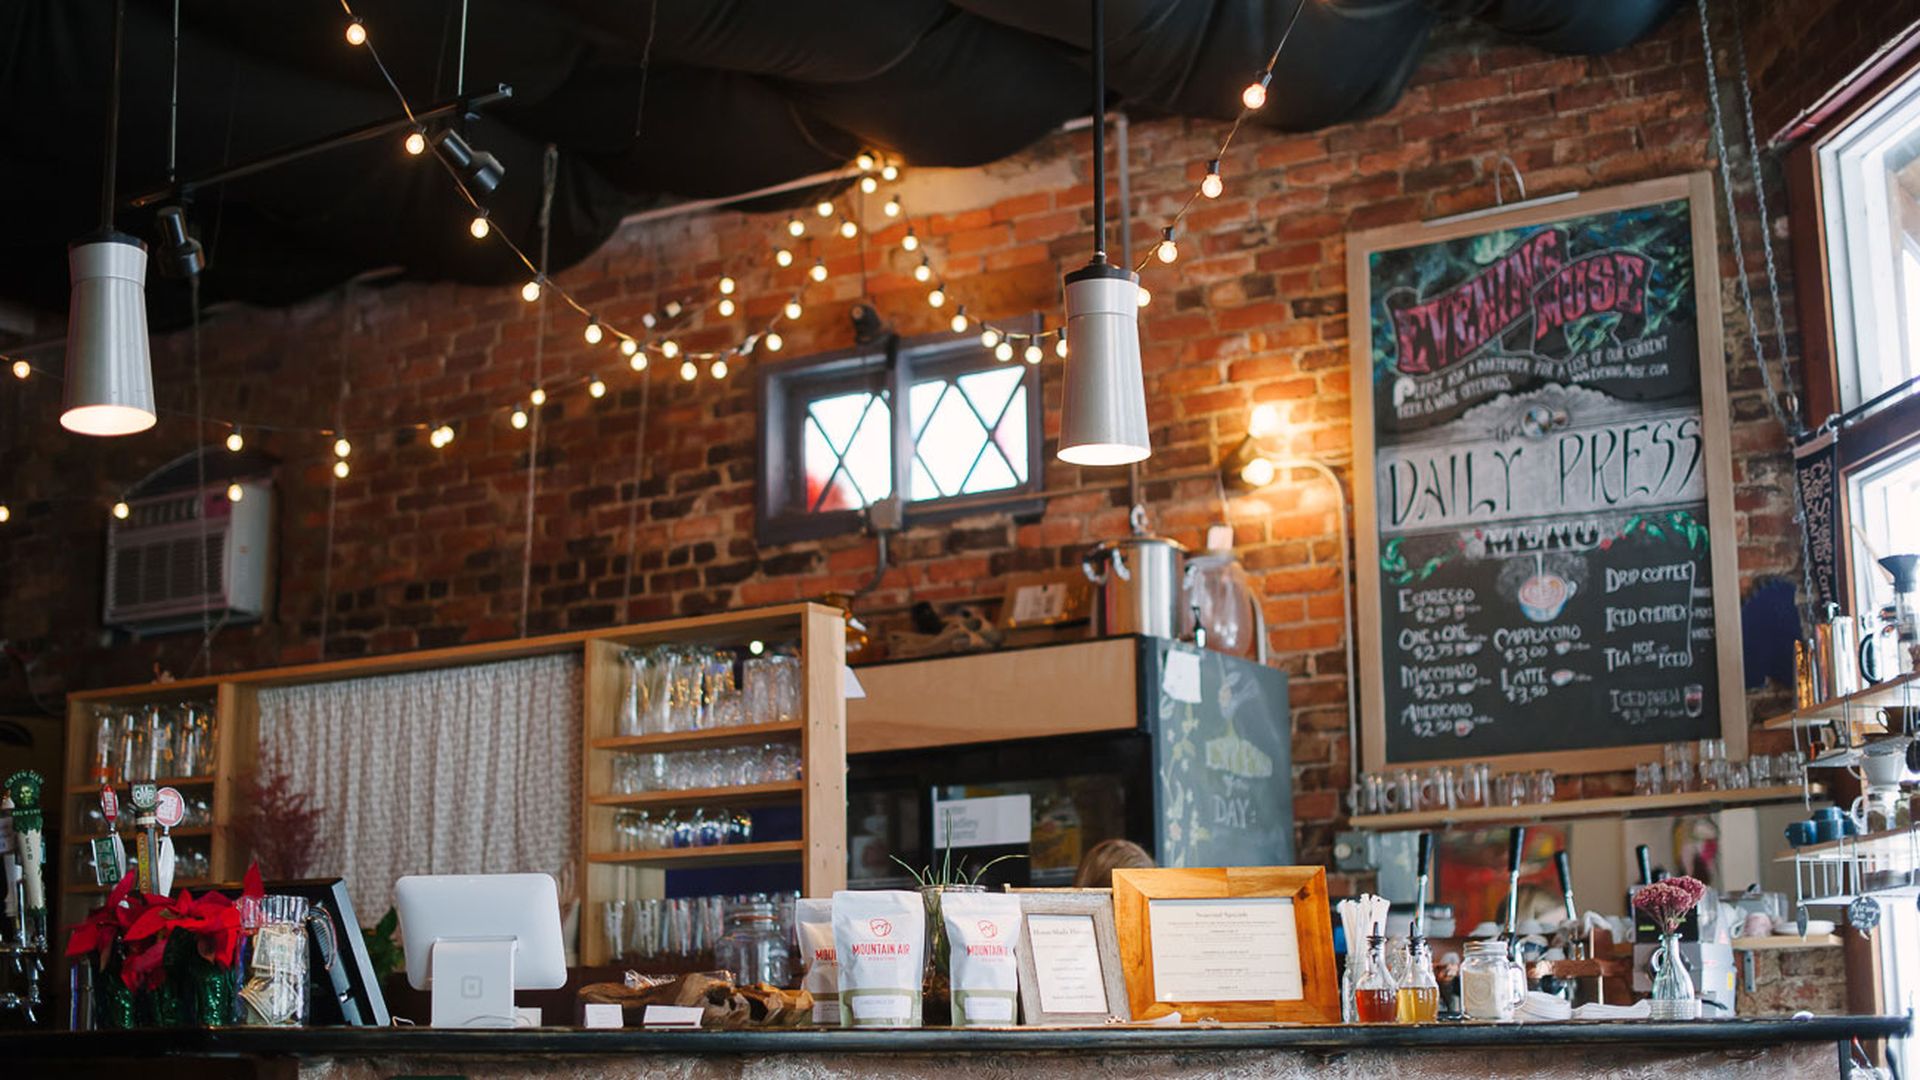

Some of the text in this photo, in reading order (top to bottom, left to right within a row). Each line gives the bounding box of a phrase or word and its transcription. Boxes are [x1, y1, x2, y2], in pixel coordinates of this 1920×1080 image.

[1395, 230, 1646, 373] EVENING MUSE
[1394, 376, 1443, 408] PLEASE
[1567, 351, 1588, 372] LIST
[1606, 345, 1624, 362] OUR
[1627, 335, 1668, 359] CURRENT
[1460, 373, 1512, 399] OFFERINGS
[1389, 417, 1702, 526] DAILY PRESS
[1484, 520, 1600, 557] MENU
[1605, 563, 1690, 593] DRIP COFFEE
[1399, 587, 1476, 613] ESPRESSO
[1606, 606, 1637, 633] ICED
[1639, 603, 1688, 623] CHEMEX
[1399, 628, 1431, 651] ONE
[1441, 622, 1472, 643] ONE
[1505, 645, 1548, 666] $3.00
[1602, 647, 1631, 673] TEA
[1632, 639, 1655, 654] HOT
[1658, 652, 1688, 669] ICED
[1501, 667, 1548, 692] LATTE
[1507, 684, 1548, 705] $3.50
[1610, 689, 1647, 713] ICED
[1400, 702, 1474, 726] AMERICANO
[851, 943, 896, 956] MOUNTAIN
